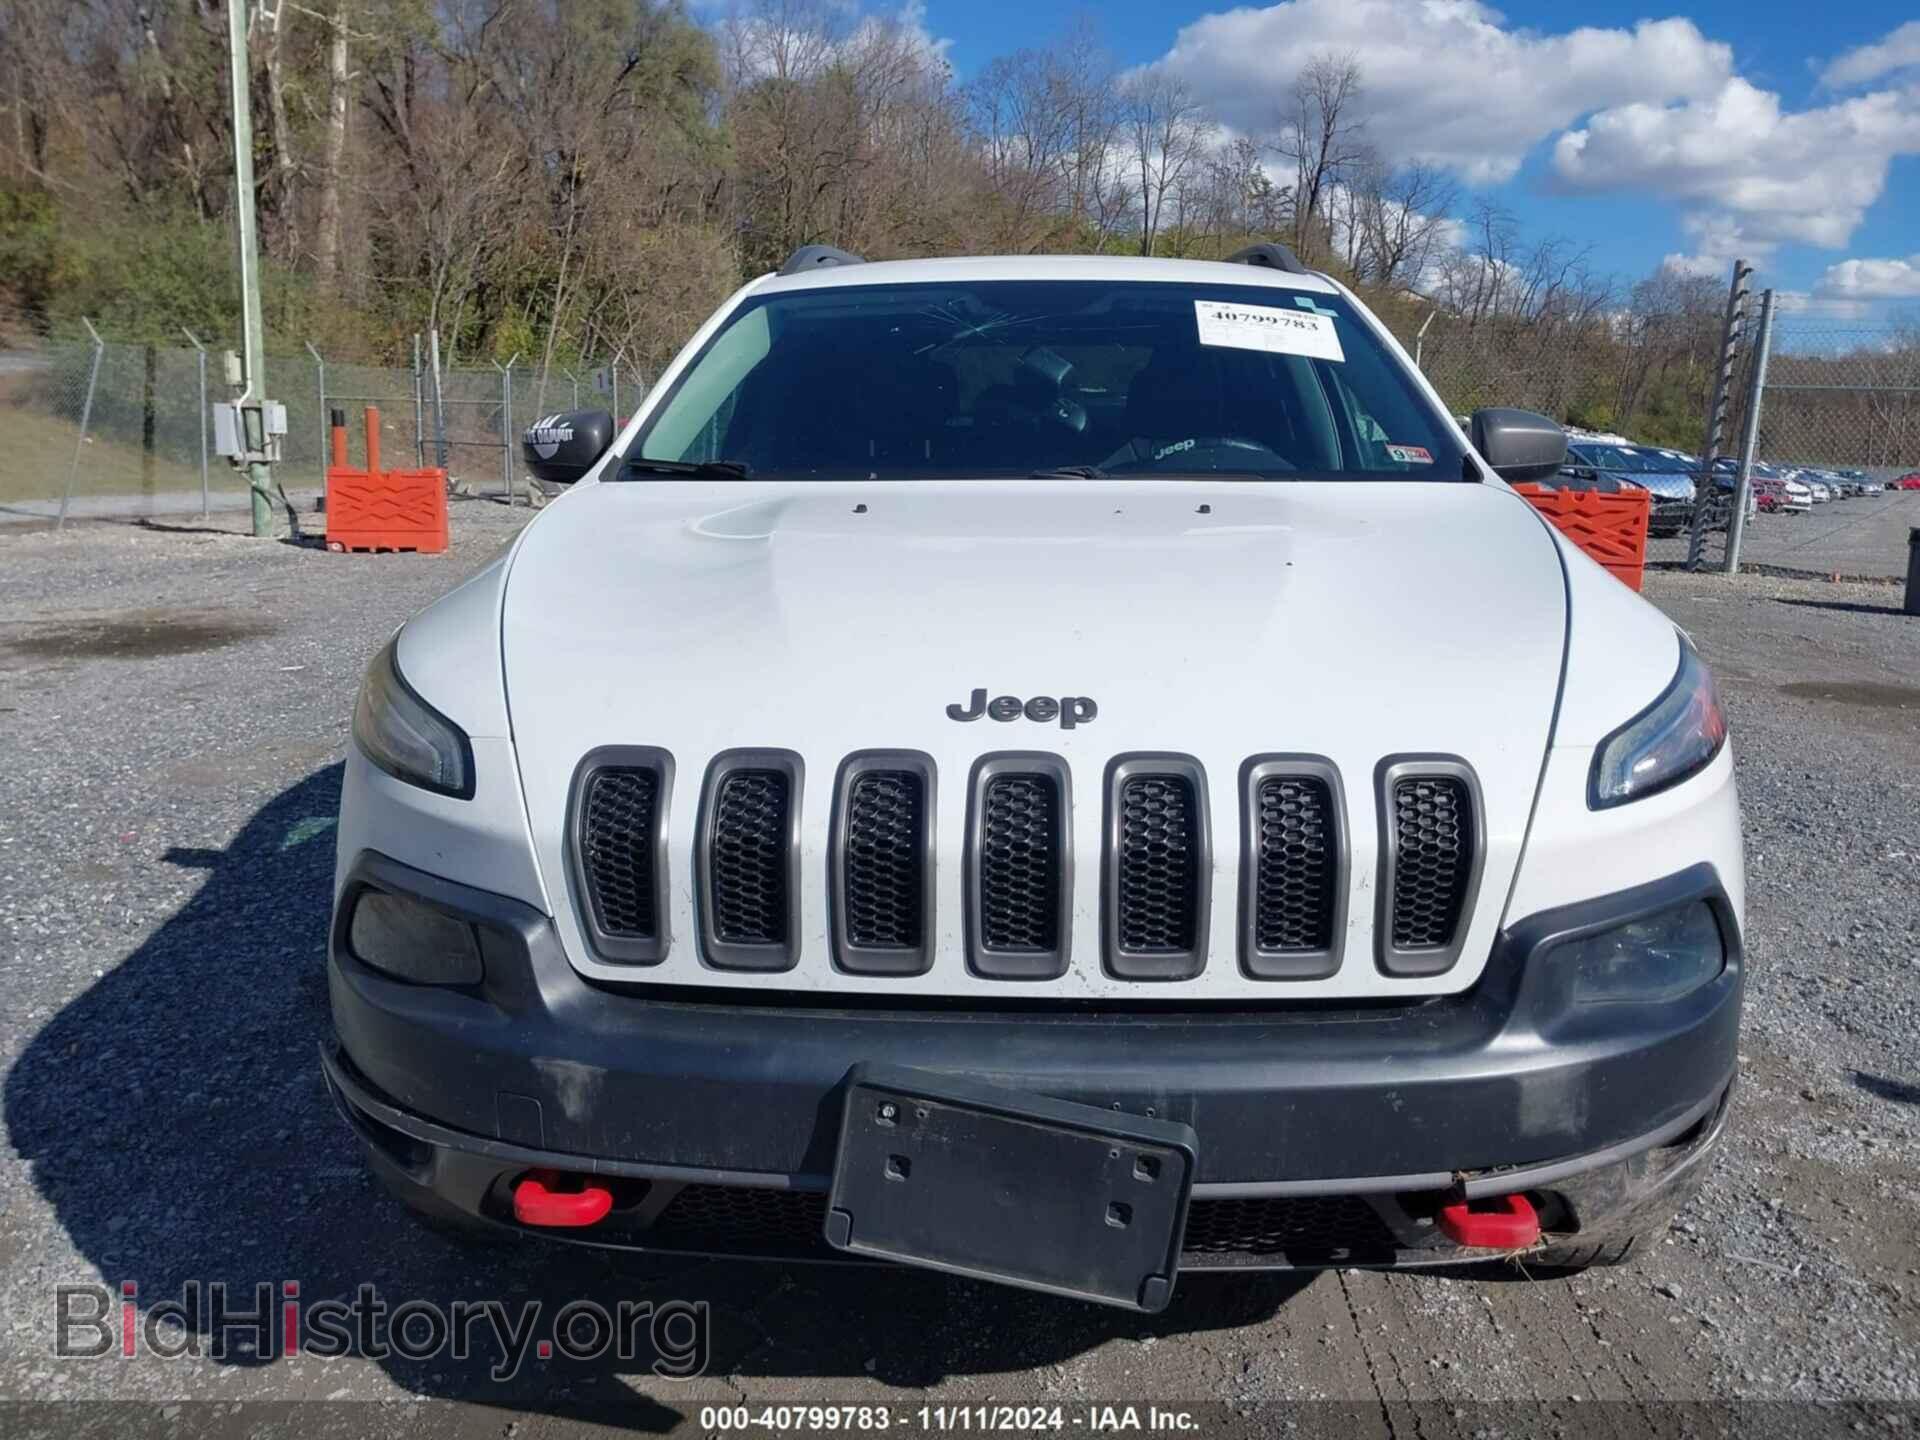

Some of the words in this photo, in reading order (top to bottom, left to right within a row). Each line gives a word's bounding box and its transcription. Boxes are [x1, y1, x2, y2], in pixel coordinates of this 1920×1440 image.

[1210, 311, 1320, 331] 40799783
[1154, 438, 1196, 460] Jeep
[946, 688, 1098, 730] Jeep
